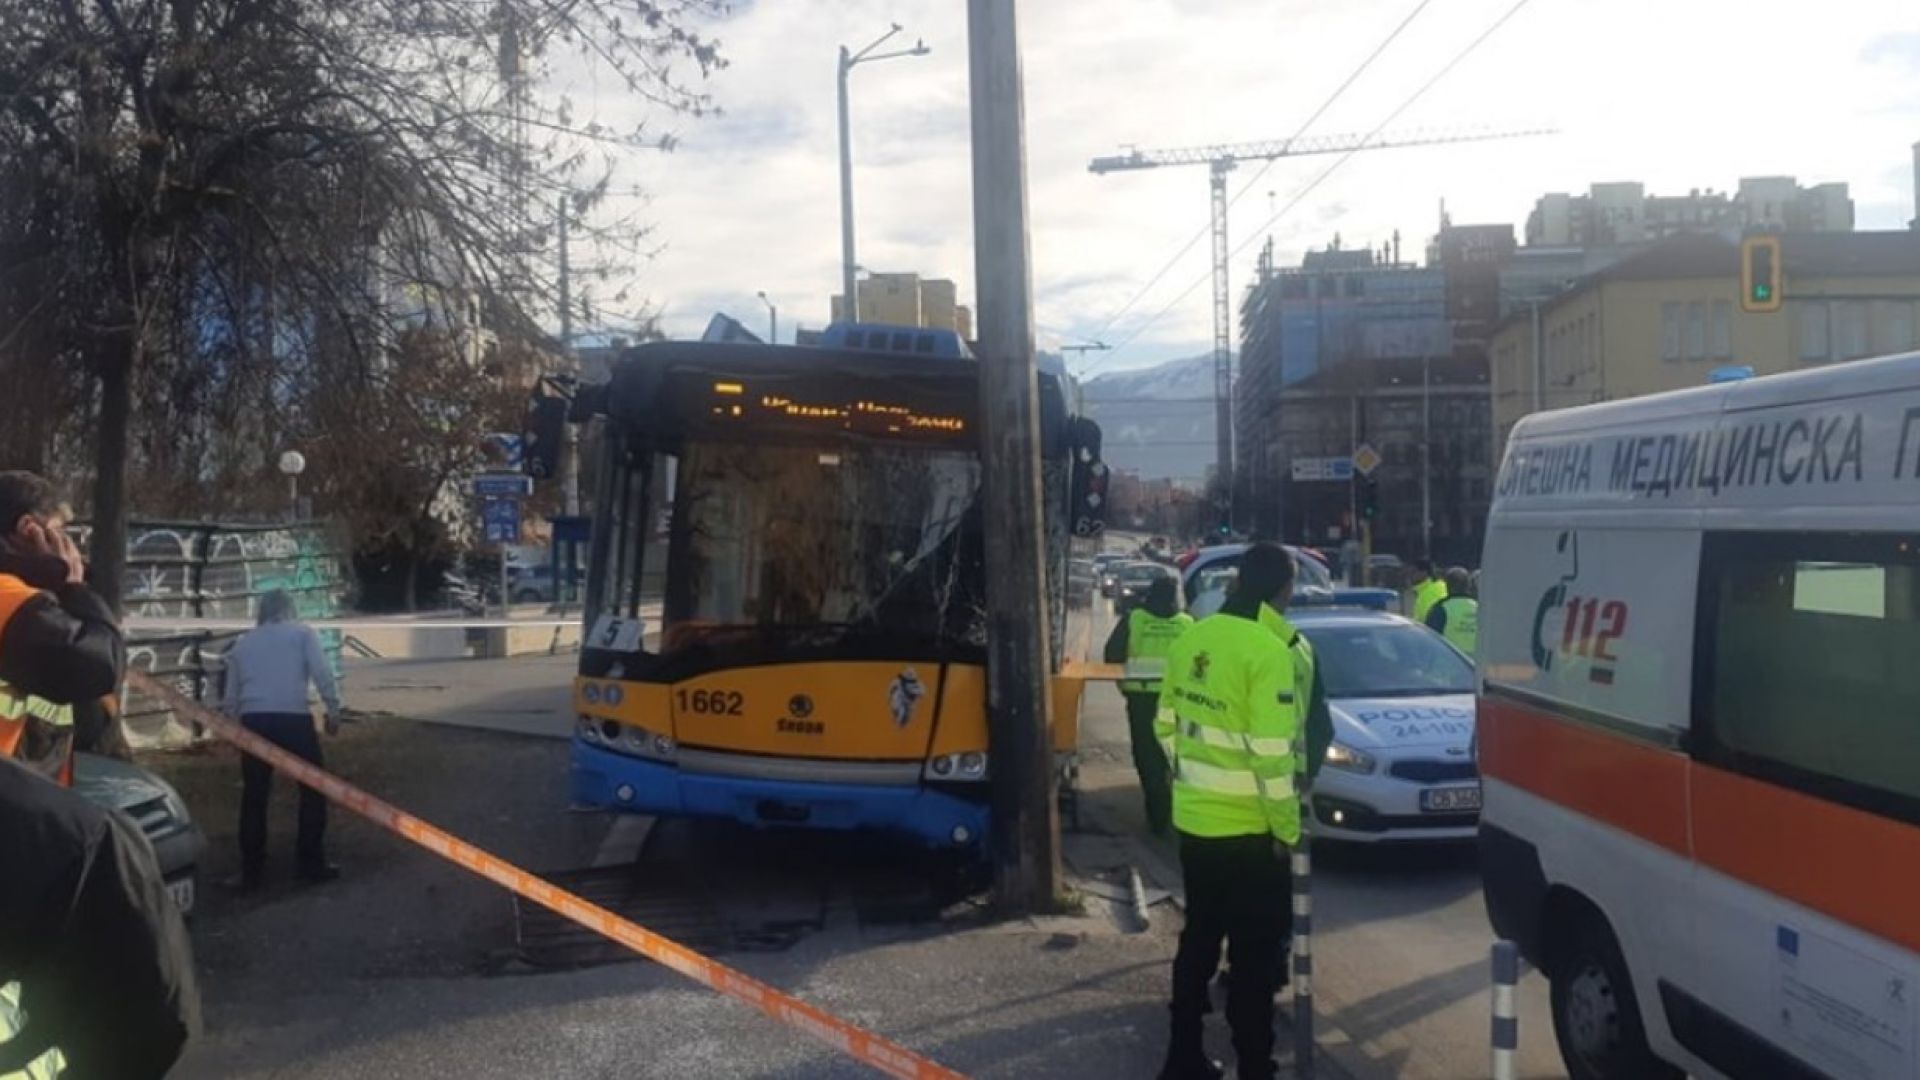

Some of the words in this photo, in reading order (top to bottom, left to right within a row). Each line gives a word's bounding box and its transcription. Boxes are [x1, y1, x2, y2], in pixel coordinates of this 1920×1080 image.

[1608, 413, 1863, 498] МЕДИЦИНСКА
[602, 620, 624, 647] 5
[1561, 595, 1628, 661] 112
[676, 688, 744, 716] 1662
